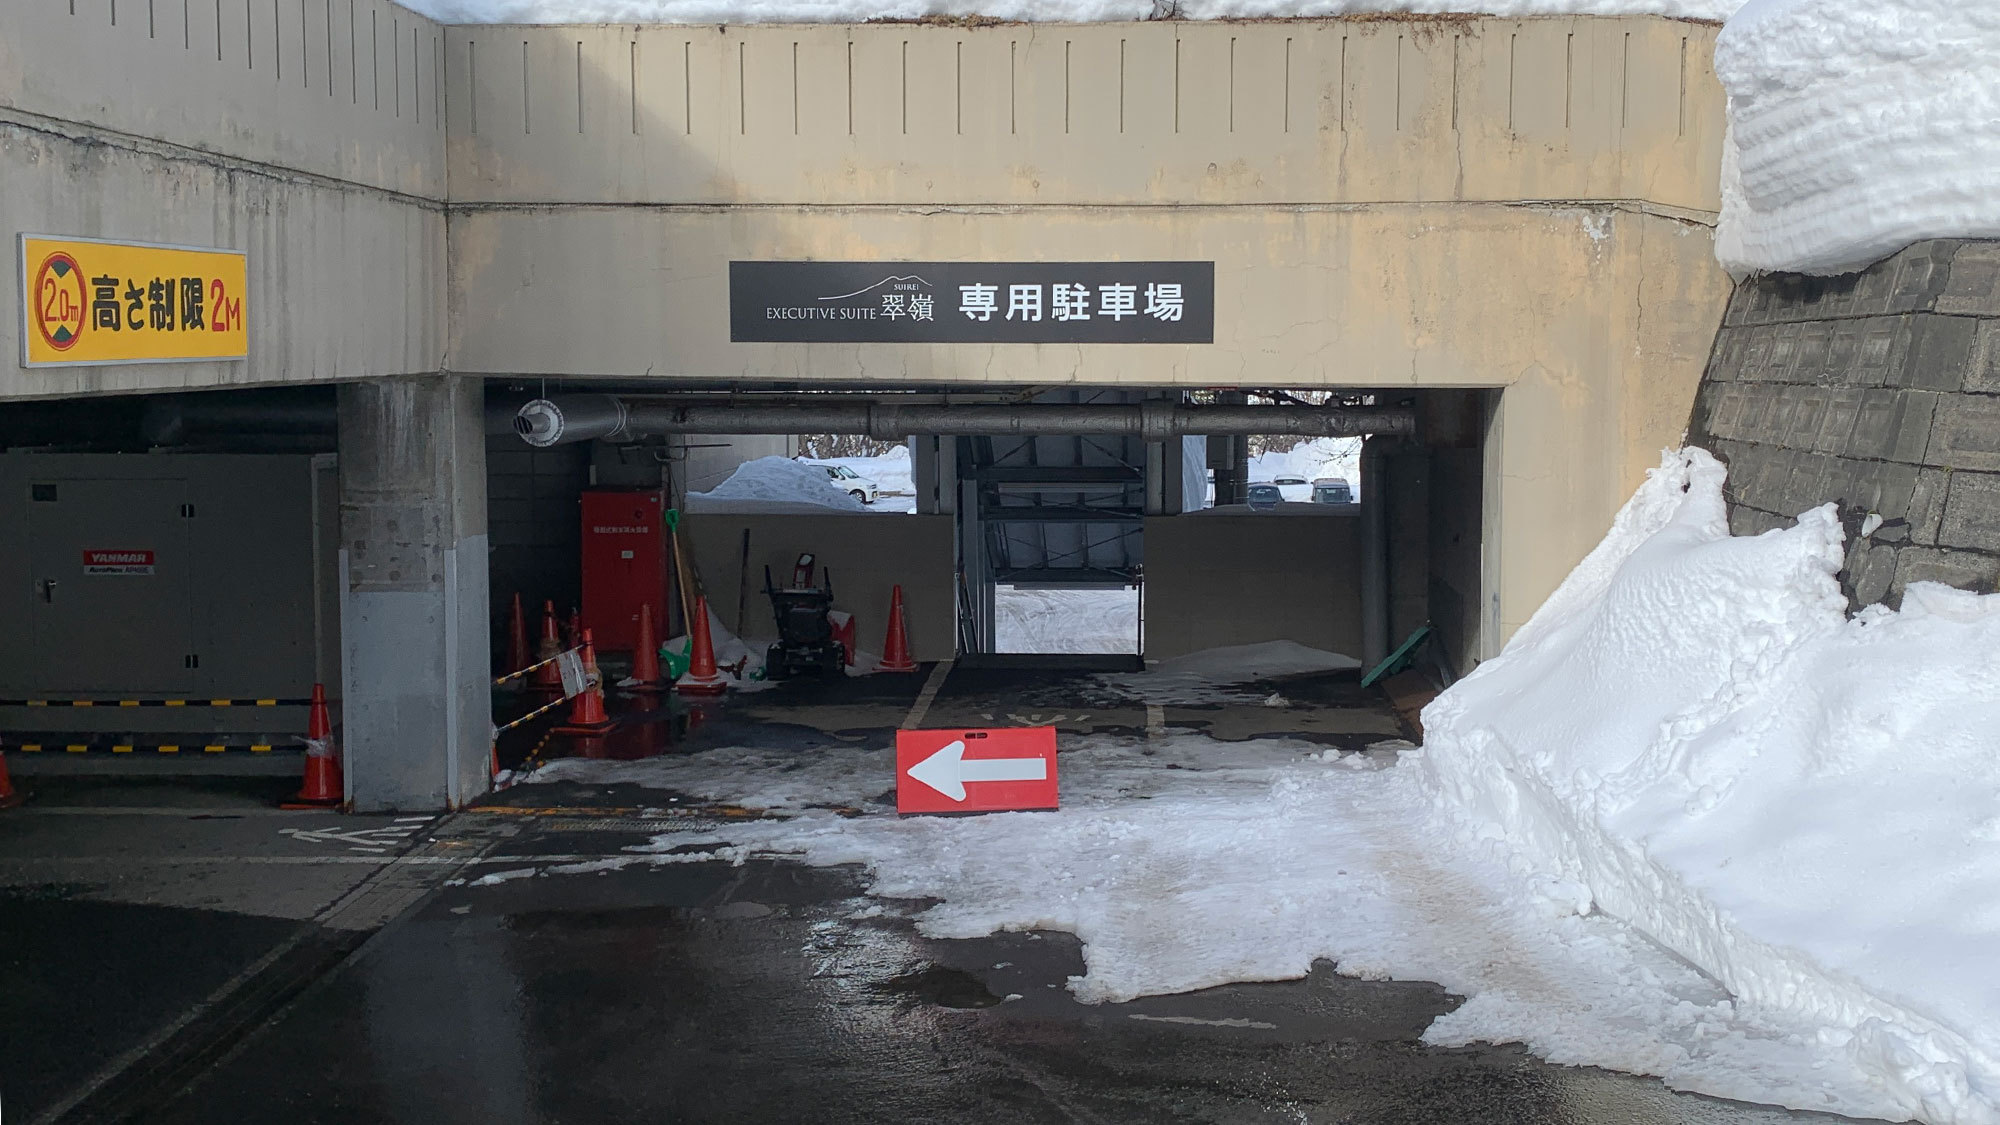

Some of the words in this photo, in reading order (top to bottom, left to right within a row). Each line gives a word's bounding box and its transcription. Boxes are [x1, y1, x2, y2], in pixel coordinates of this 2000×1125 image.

[44, 277, 79, 322] 2.0m
[893, 283, 919, 291] SUIREI
[766, 307, 836, 320] EXECUTIVE
[839, 307, 877, 320] SUITE
[880, 293, 935, 322] 翠嶺
[958, 282, 1185, 322] 専用駐車場
[91, 553, 147, 563] YANMAR
